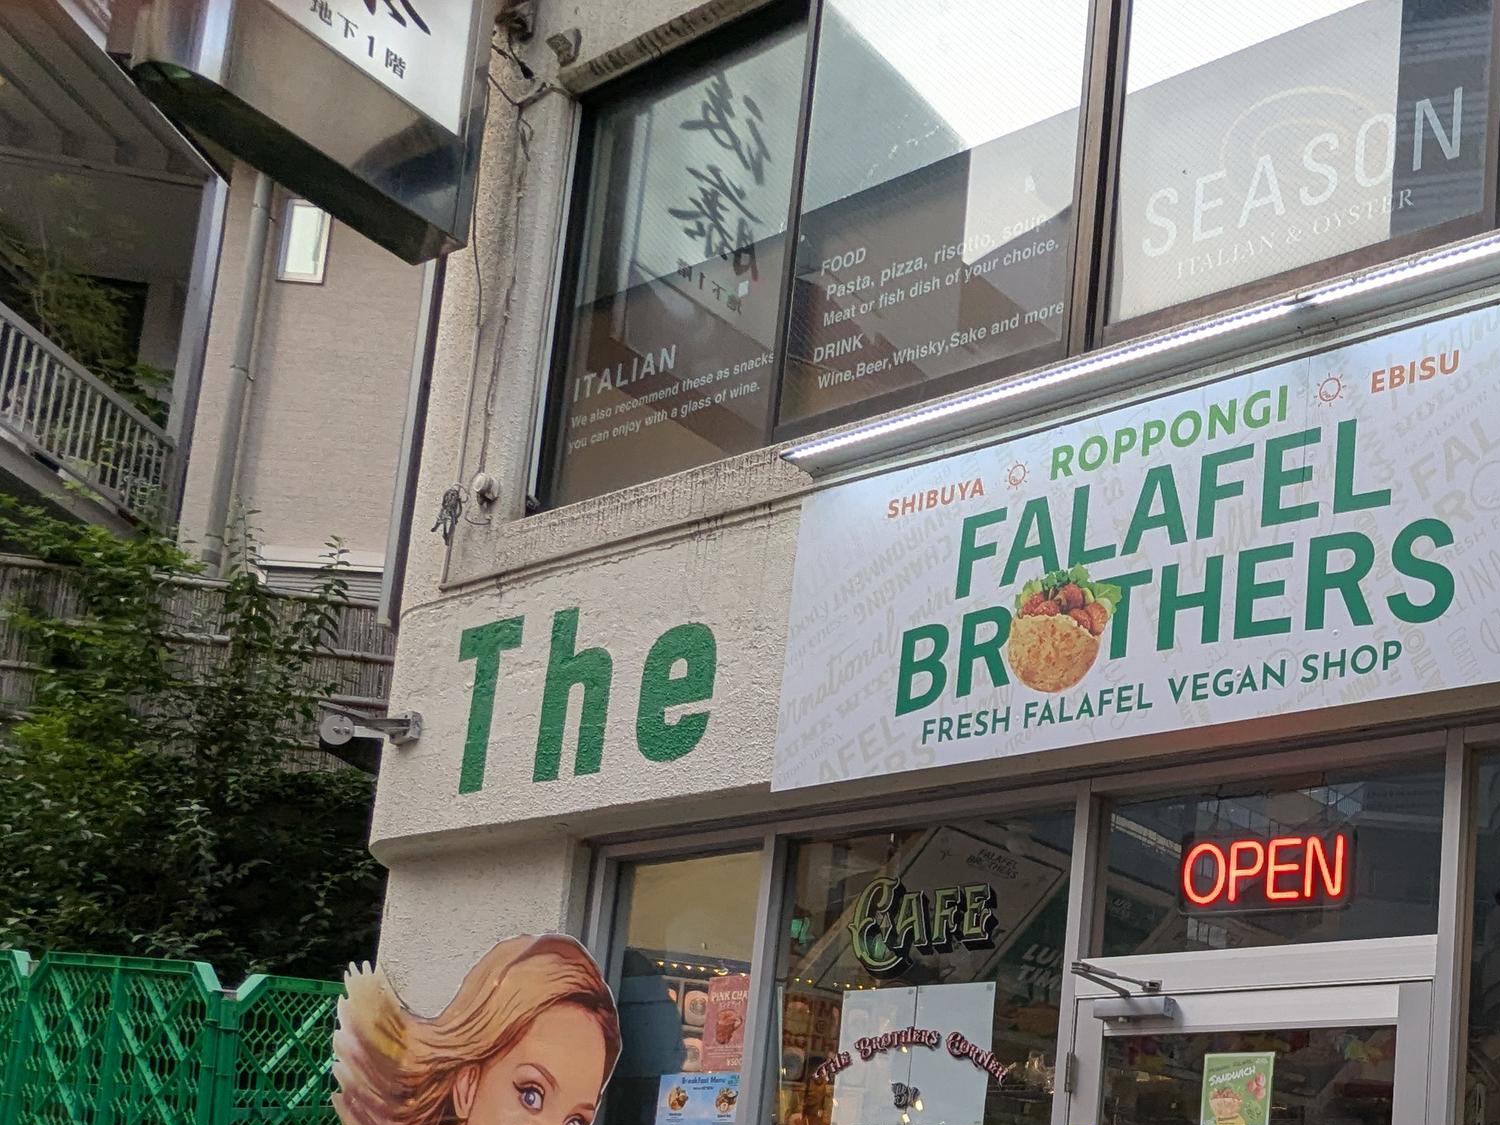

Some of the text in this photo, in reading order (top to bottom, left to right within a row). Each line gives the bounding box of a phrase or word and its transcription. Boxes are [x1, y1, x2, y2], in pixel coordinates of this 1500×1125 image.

[1142, 86, 1463, 257] SEASON
[821, 247, 867, 277] FOOD
[824, 237, 1059, 327] Meat or fish dish of your choice.
[880, 256, 928, 283] pizza,
[813, 333, 864, 365] DRINK
[991, 313, 1019, 335] and
[1024, 300, 1065, 323] more
[571, 352, 775, 429] We also recommend these as snacks
[573, 344, 676, 402] ITALIAN
[1370, 349, 1460, 394] EBISU
[568, 436, 588, 455] you
[590, 430, 610, 444] can
[612, 419, 641, 439] enjoy
[645, 411, 668, 426] with
[681, 395, 711, 418] glass
[715, 391, 727, 404] of
[1049, 385, 1289, 480] ROPPONGI
[886, 477, 984, 519] SHIBUYA
[954, 417, 1392, 600] FALAFEL
[894, 517, 1456, 718] BROTHERS
[458, 607, 717, 795] The
[920, 639, 1403, 745] FRESH FALAFEL VEGAN SHOP
[1182, 833, 1345, 904] OPEN
